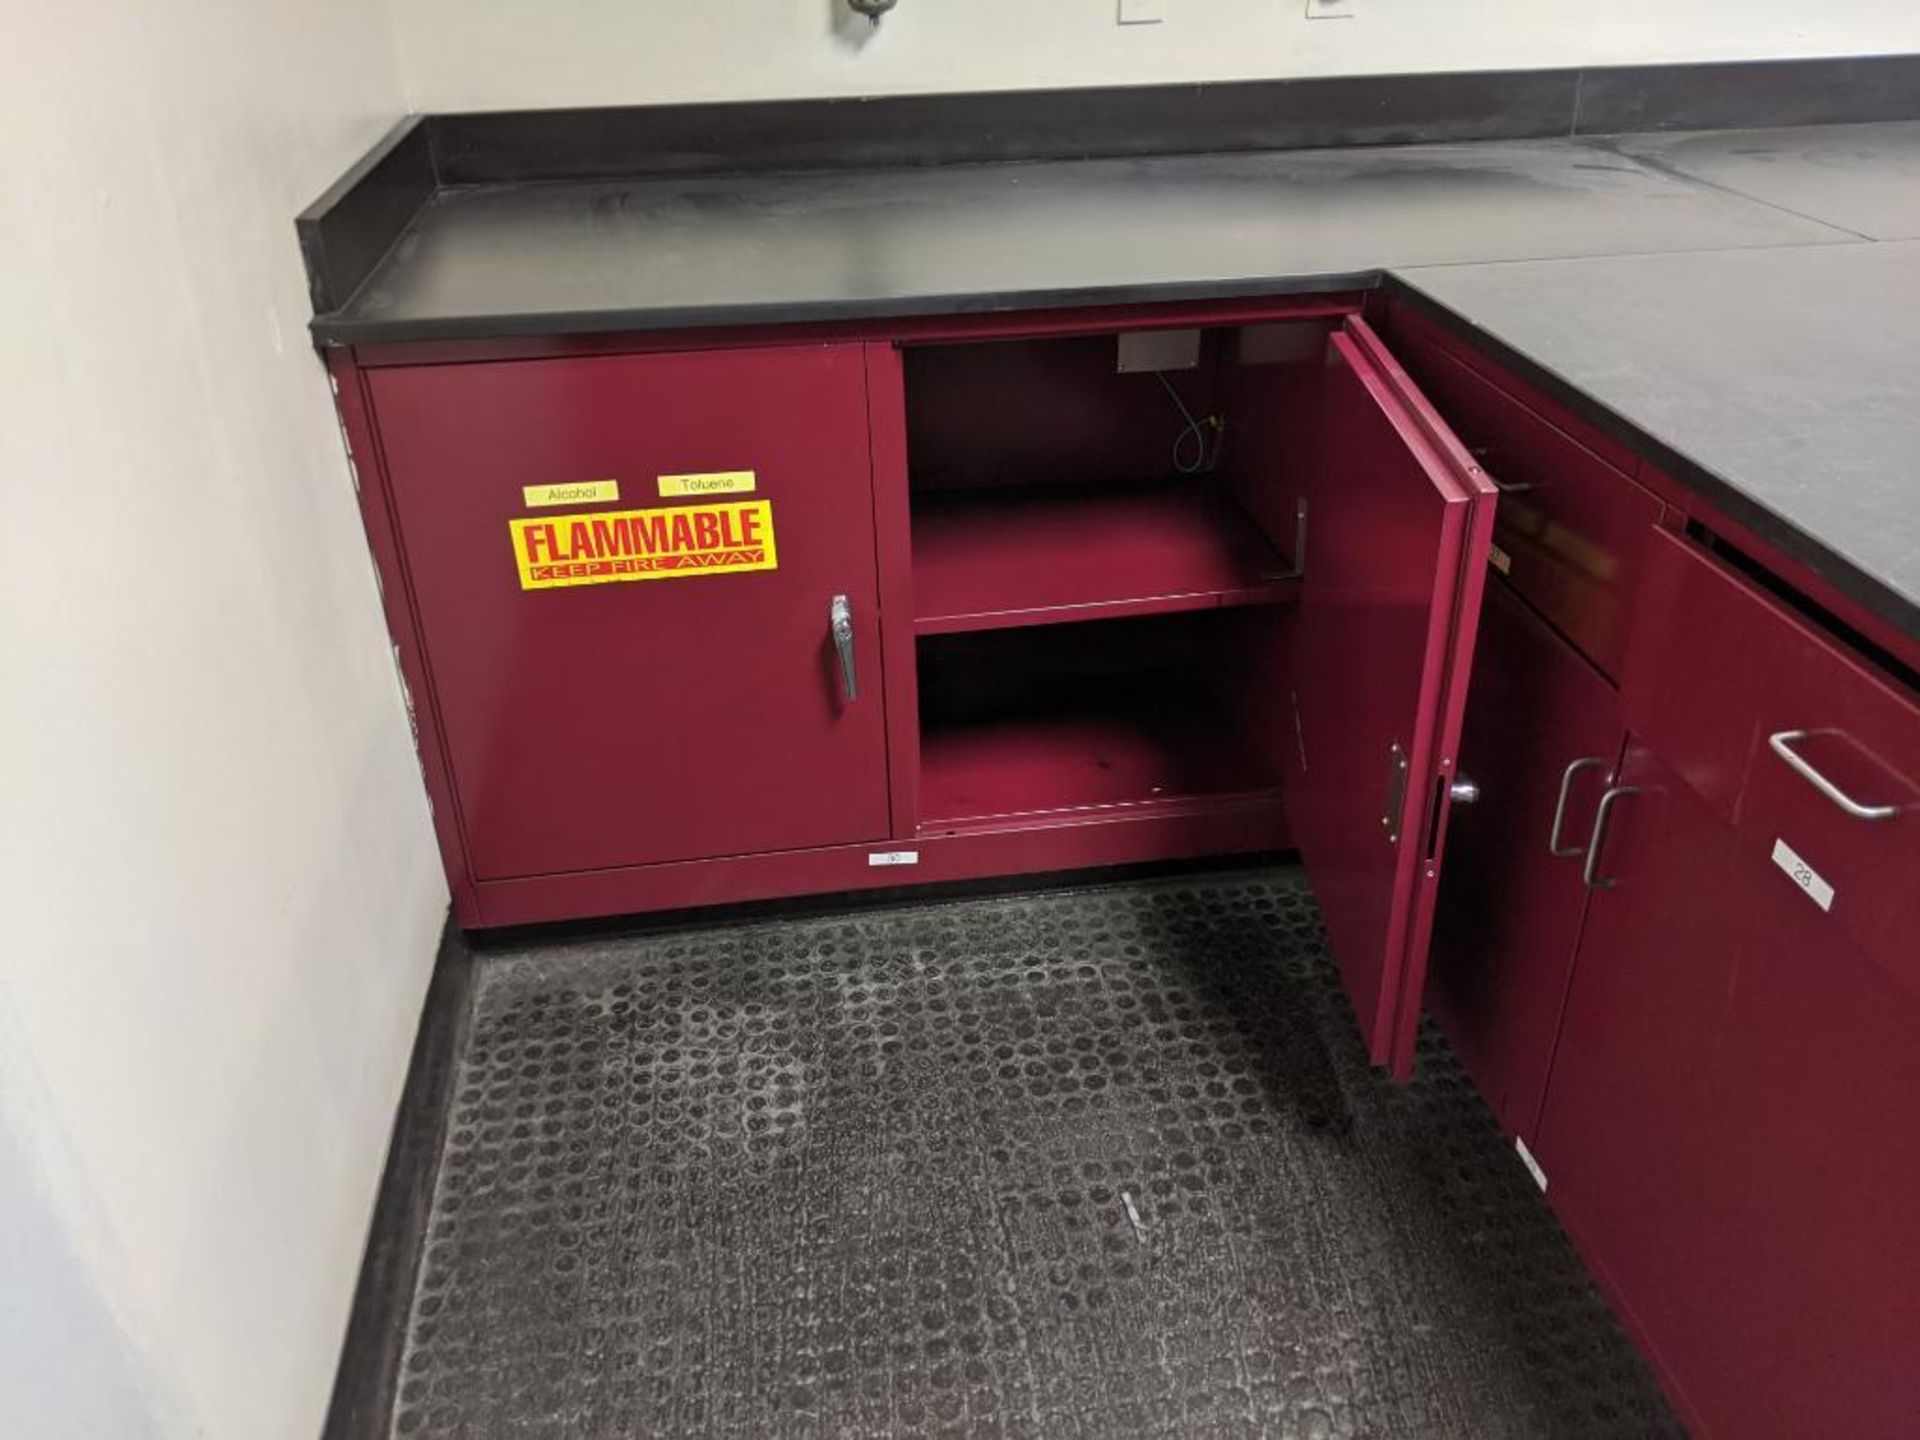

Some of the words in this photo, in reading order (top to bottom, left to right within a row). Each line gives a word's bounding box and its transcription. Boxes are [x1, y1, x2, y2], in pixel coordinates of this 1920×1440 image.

[548, 488, 597, 501] Alcohol
[681, 479, 734, 491] Toluene
[523, 508, 763, 563] FLAMMABLE
[532, 565, 600, 580] KEEP
[612, 559, 667, 573] FIRE
[678, 550, 763, 567] AWAY
[1795, 863, 1811, 886] 28
